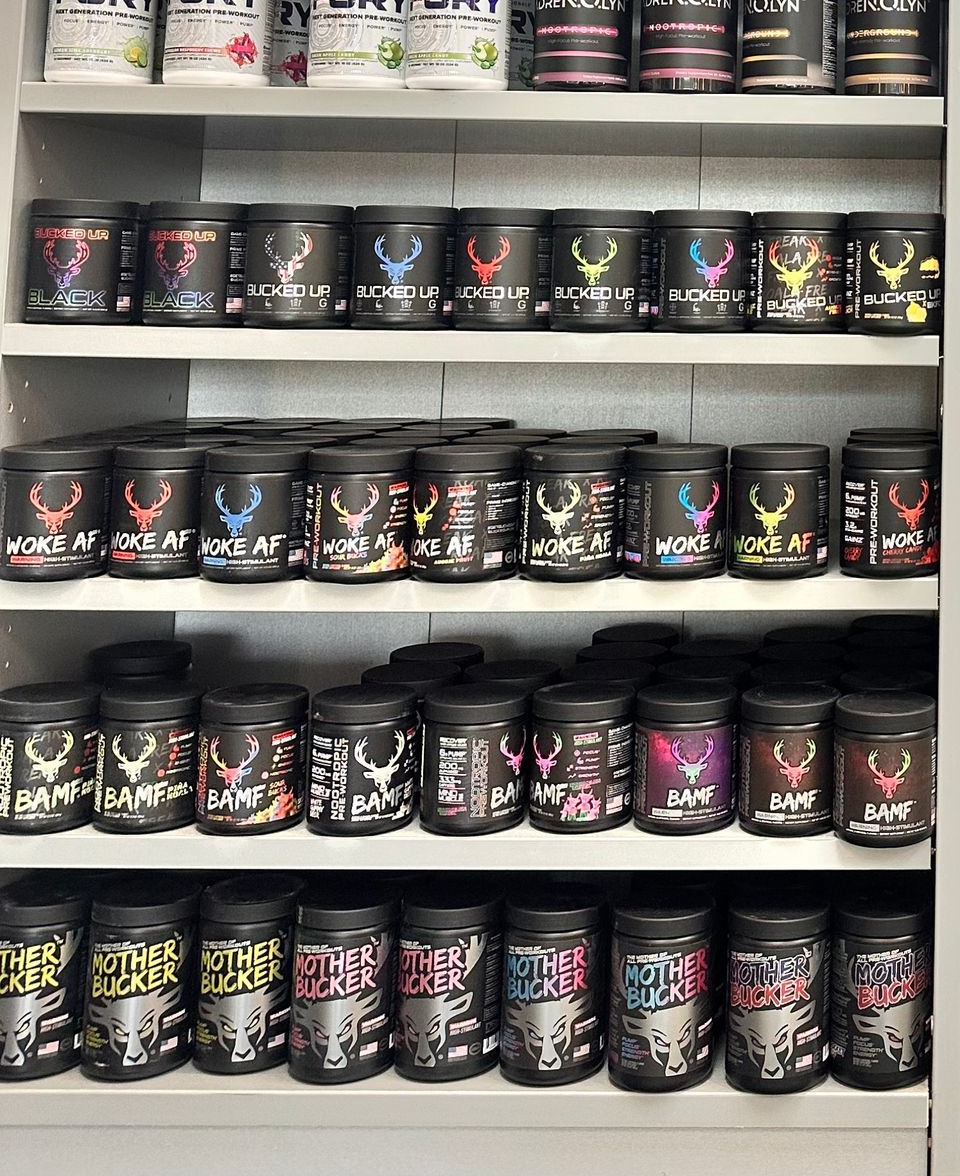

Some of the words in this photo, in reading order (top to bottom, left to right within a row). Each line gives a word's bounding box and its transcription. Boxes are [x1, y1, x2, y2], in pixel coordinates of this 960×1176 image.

[34, 229, 85, 240] BUCKED
[87, 229, 109, 240] UP
[194, 231, 217, 241] UP
[247, 283, 305, 297] BUCKED
[756, 238, 765, 319] PRE-WORKOUT
[27, 289, 107, 308] BLACK
[144, 290, 214, 309] BLACK
[356, 285, 416, 299] BUCKED
[455, 286, 505, 299] BUCKED
[554, 286, 611, 299] BUCKED
[668, 288, 730, 302] BUCKED
[766, 296, 826, 310] BUCKED
[863, 291, 927, 305] BUCKED
[311, 482, 322, 570] PRE-WORKOUT
[869, 479, 879, 566] PRE-WORKOUT
[6, 534, 67, 555] WOKE
[72, 531, 97, 551] AF
[111, 532, 158, 553] WOKE
[162, 530, 190, 551] AF
[202, 536, 248, 556] WOKE
[252, 535, 281, 556] AF
[322, 537, 368, 555] WOKE
[532, 537, 586, 557] WOKE
[655, 534, 709, 556] WOKE
[733, 535, 782, 556] WOKE
[787, 533, 813, 555] AF
[881, 533, 924, 549] WOKE
[330, 737, 342, 820] NOOTROPIC
[338, 737, 349, 821] PRE-WORKOUT
[14, 781, 81, 813] BAMF
[207, 786, 265, 812] BAMF
[351, 784, 404, 813] BAMF
[667, 785, 716, 808] BAMF
[769, 789, 818, 812] BAMF
[864, 801, 913, 823] BAMF
[93, 939, 179, 974] MOTHER
[201, 938, 284, 973] MOTHER
[295, 943, 376, 976] MOTHER
[401, 946, 466, 974] OTHER
[508, 945, 588, 979] MOTHER
[624, 947, 710, 987] MOTHER
[91, 963, 179, 998] BUCKER
[201, 960, 284, 995] BUCKER
[401, 968, 466, 994] UCKER
[729, 953, 809, 986] MOTHER
[295, 966, 376, 1000] BUCKER
[507, 968, 589, 1001] BUCKER
[626, 973, 710, 1009] BUCKER
[730, 977, 810, 1009] BUCKER
